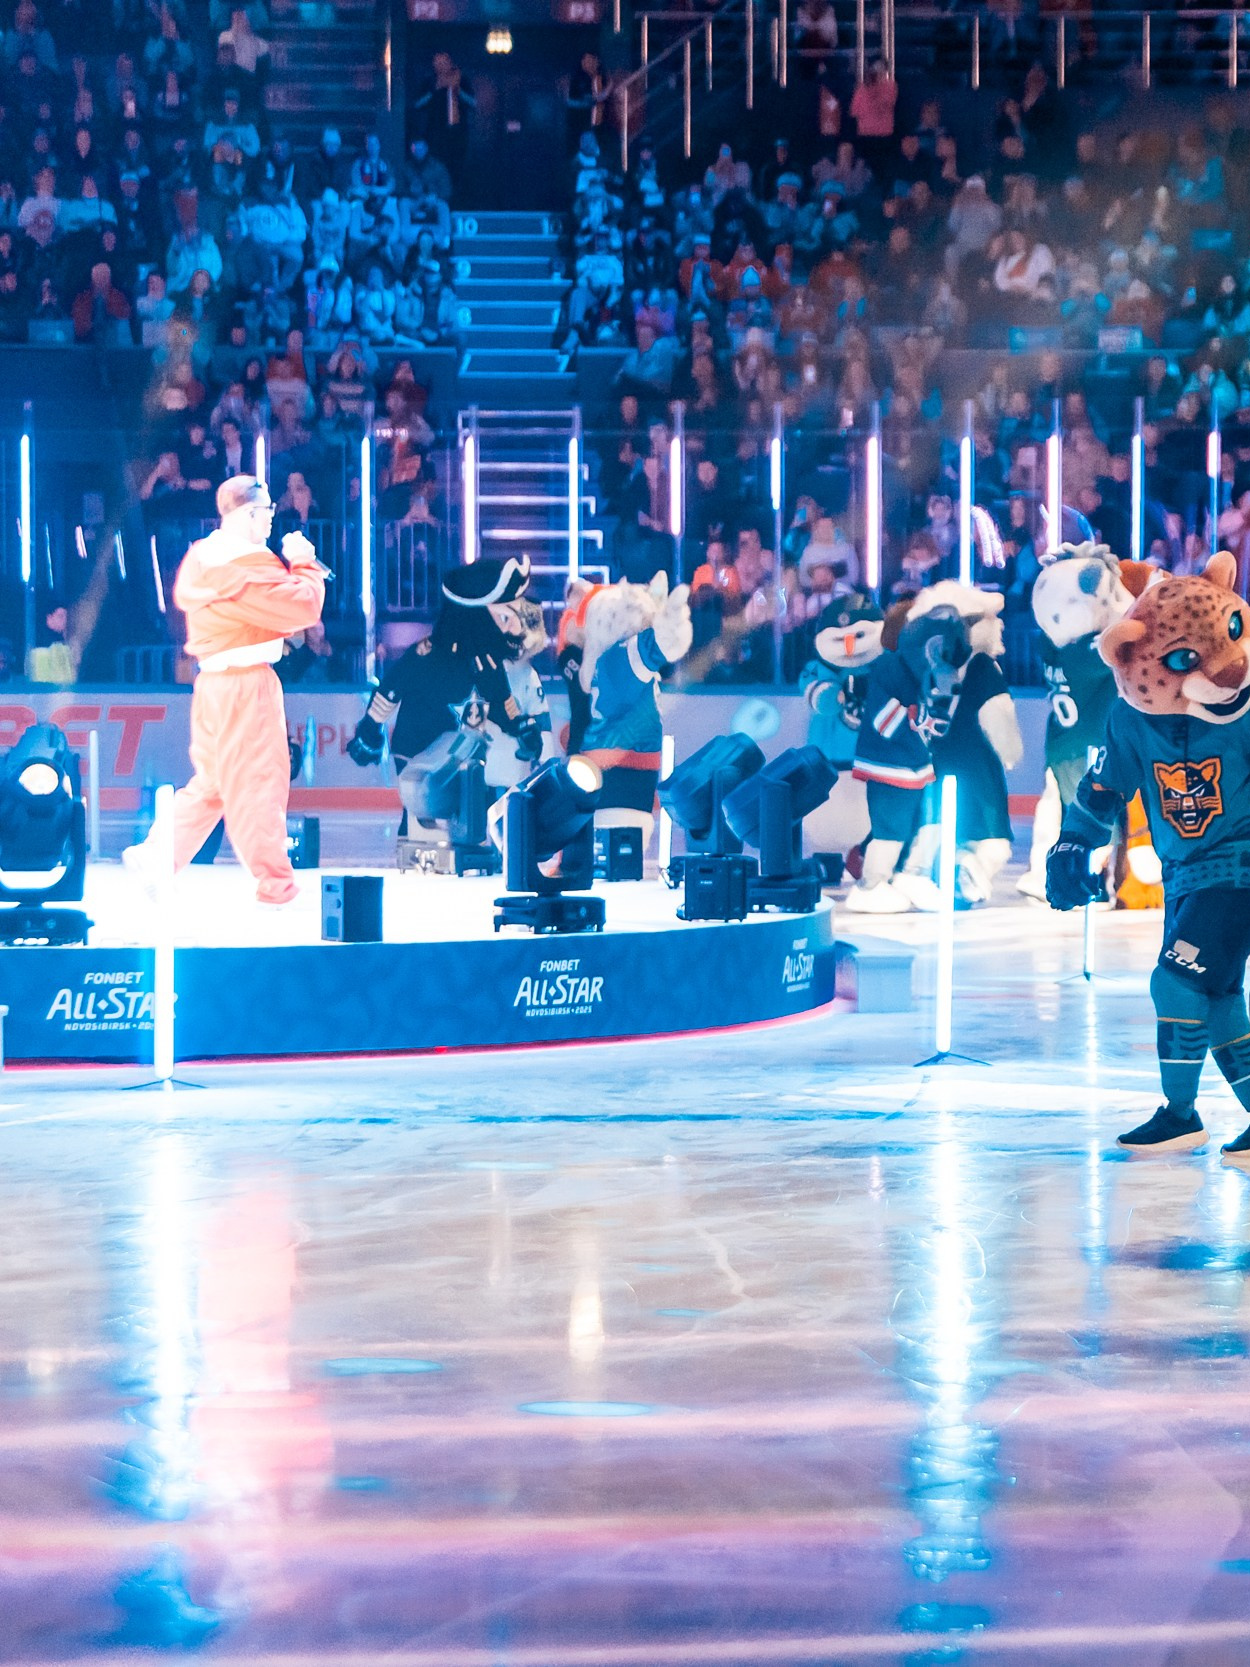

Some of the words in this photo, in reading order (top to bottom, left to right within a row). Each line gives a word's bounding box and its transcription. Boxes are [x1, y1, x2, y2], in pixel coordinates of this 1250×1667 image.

[456, 216, 478, 236] 10
[1052, 693, 1079, 729] 0
[1092, 745, 1109, 776] 3
[1047, 842, 1085, 859] UER
[539, 958, 581, 973] FONBET
[1164, 949, 1207, 974] CCM
[83, 971, 145, 985] FONBET
[103, 987, 179, 1020] STA
[525, 1006, 571, 1017] NOVOSIBIRSK
[575, 1005, 592, 1014] 2025
[64, 1022, 131, 1031] NOVOSIBIRSK
[138, 1021, 156, 1030] 20
